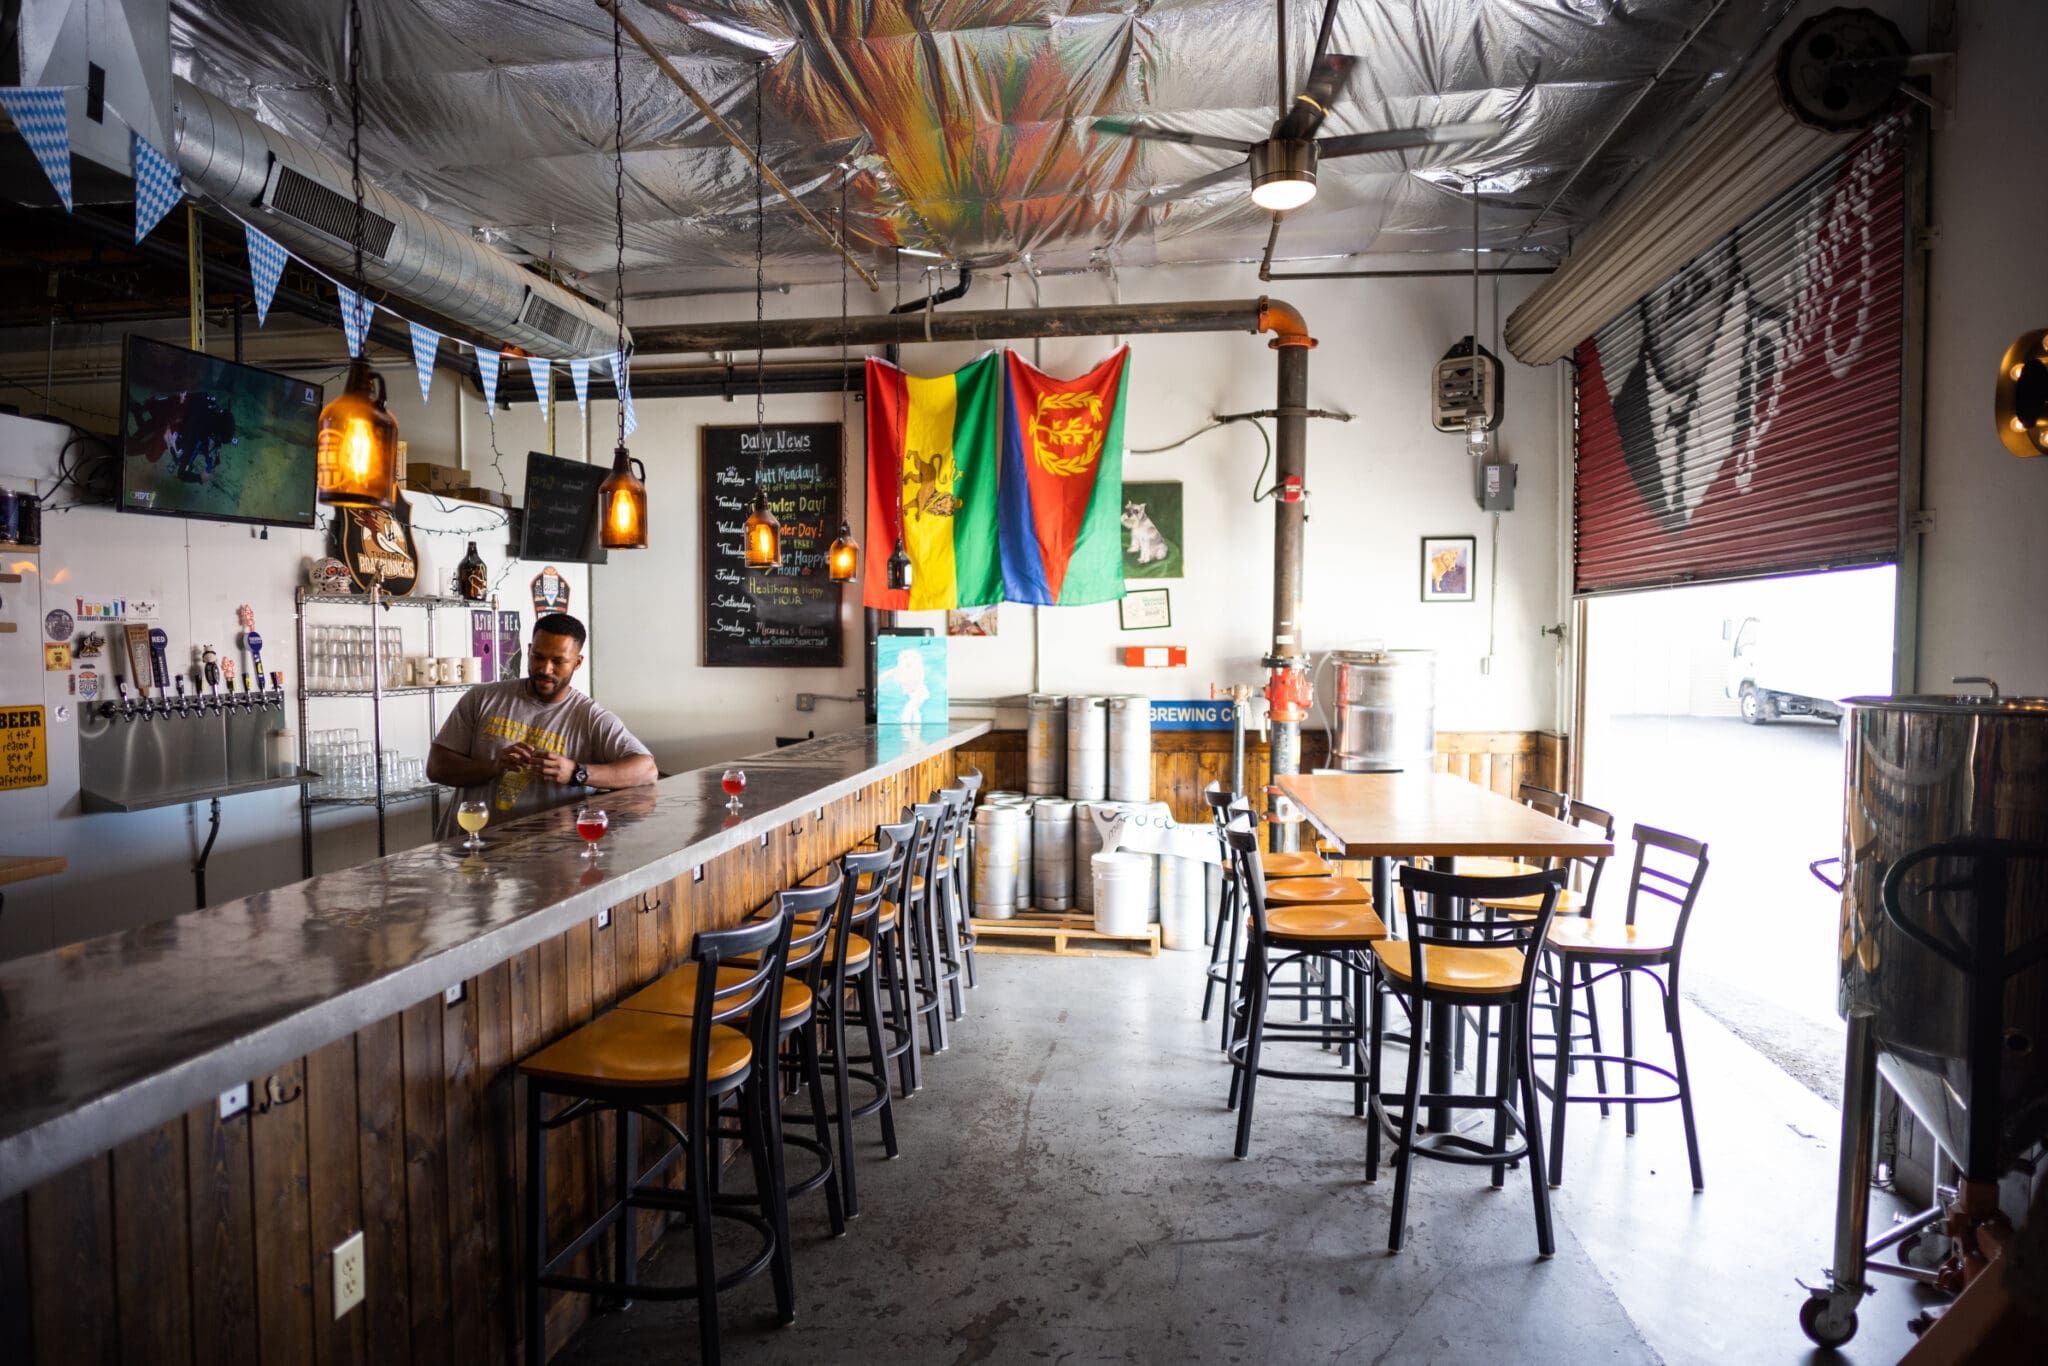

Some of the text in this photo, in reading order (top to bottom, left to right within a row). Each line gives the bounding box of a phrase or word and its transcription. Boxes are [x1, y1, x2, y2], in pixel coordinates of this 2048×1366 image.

[777, 431, 811, 449] News
[799, 496, 827, 516] Day!
[798, 520, 824, 539] Day!
[795, 550, 824, 568] Happy
[749, 577, 798, 594] Healthcare
[151, 635, 165, 643] RED
[0, 711, 41, 729] BEER
[1150, 707, 1217, 722] BREWING
[3, 741, 29, 753] reason
